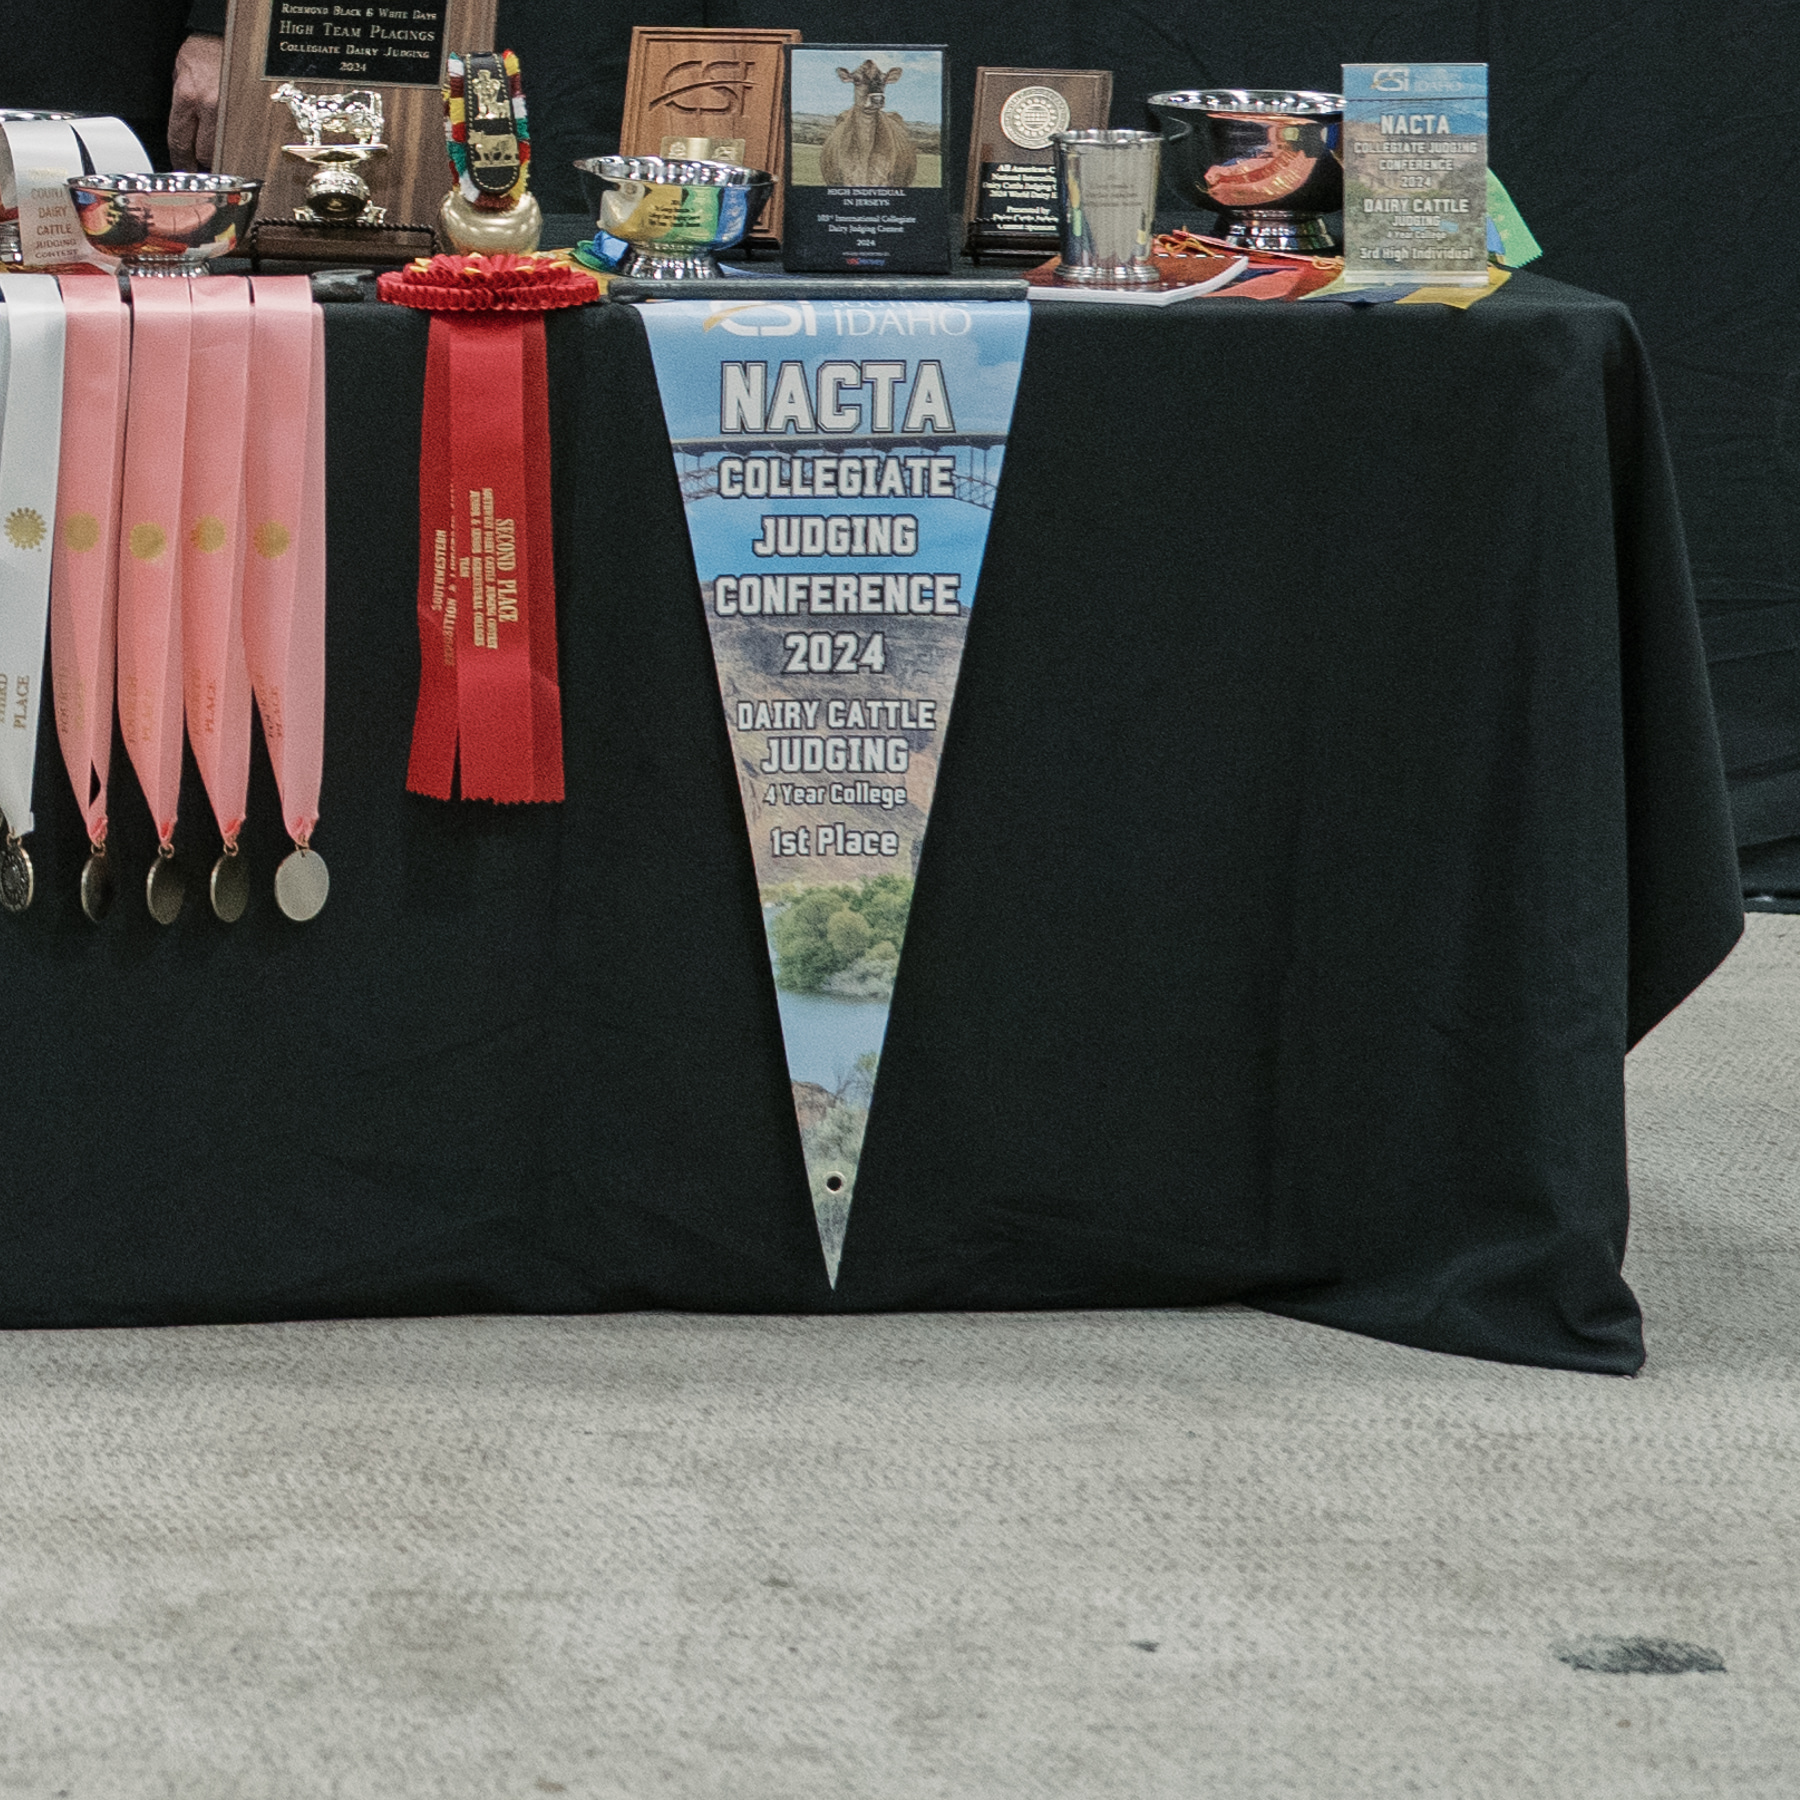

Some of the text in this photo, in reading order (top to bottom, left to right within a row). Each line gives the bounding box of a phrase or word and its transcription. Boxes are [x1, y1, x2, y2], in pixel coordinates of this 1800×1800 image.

[339, 62, 367, 72] 2024
[1380, 114, 1450, 135] NACTA
[1353, 141, 1478, 153] COLLEGIATE JUDGING
[1379, 159, 1454, 170] CONFERENCE
[1400, 176, 1432, 188] 2024
[39, 206, 67, 218] DAIRY
[1363, 198, 1469, 213] DAIRY CATTLE
[36, 224, 72, 235] CATTLE
[1392, 215, 1441, 227] JUDGING
[35, 239, 76, 249] JUDGING
[1414, 231, 1447, 240] College
[35, 249, 78, 259] CONTEST
[1360, 246, 1474, 262] 3rd High Individual
[835, 308, 972, 335] IDAHO
[721, 360, 956, 434] NACTA
[718, 455, 956, 498] COLLEGIATE
[752, 514, 918, 557] JUDGING
[495, 518, 518, 622] SECOND PLACE
[714, 573, 961, 616] CONFERENCE
[782, 631, 885, 675] 2024
[13, 675, 30, 730] PLACE
[736, 699, 937, 732] DAIRY CATTLE
[759, 735, 908, 774] JUDGING
[763, 781, 907, 810] 4 Year College
[771, 822, 899, 858] 1st Place
